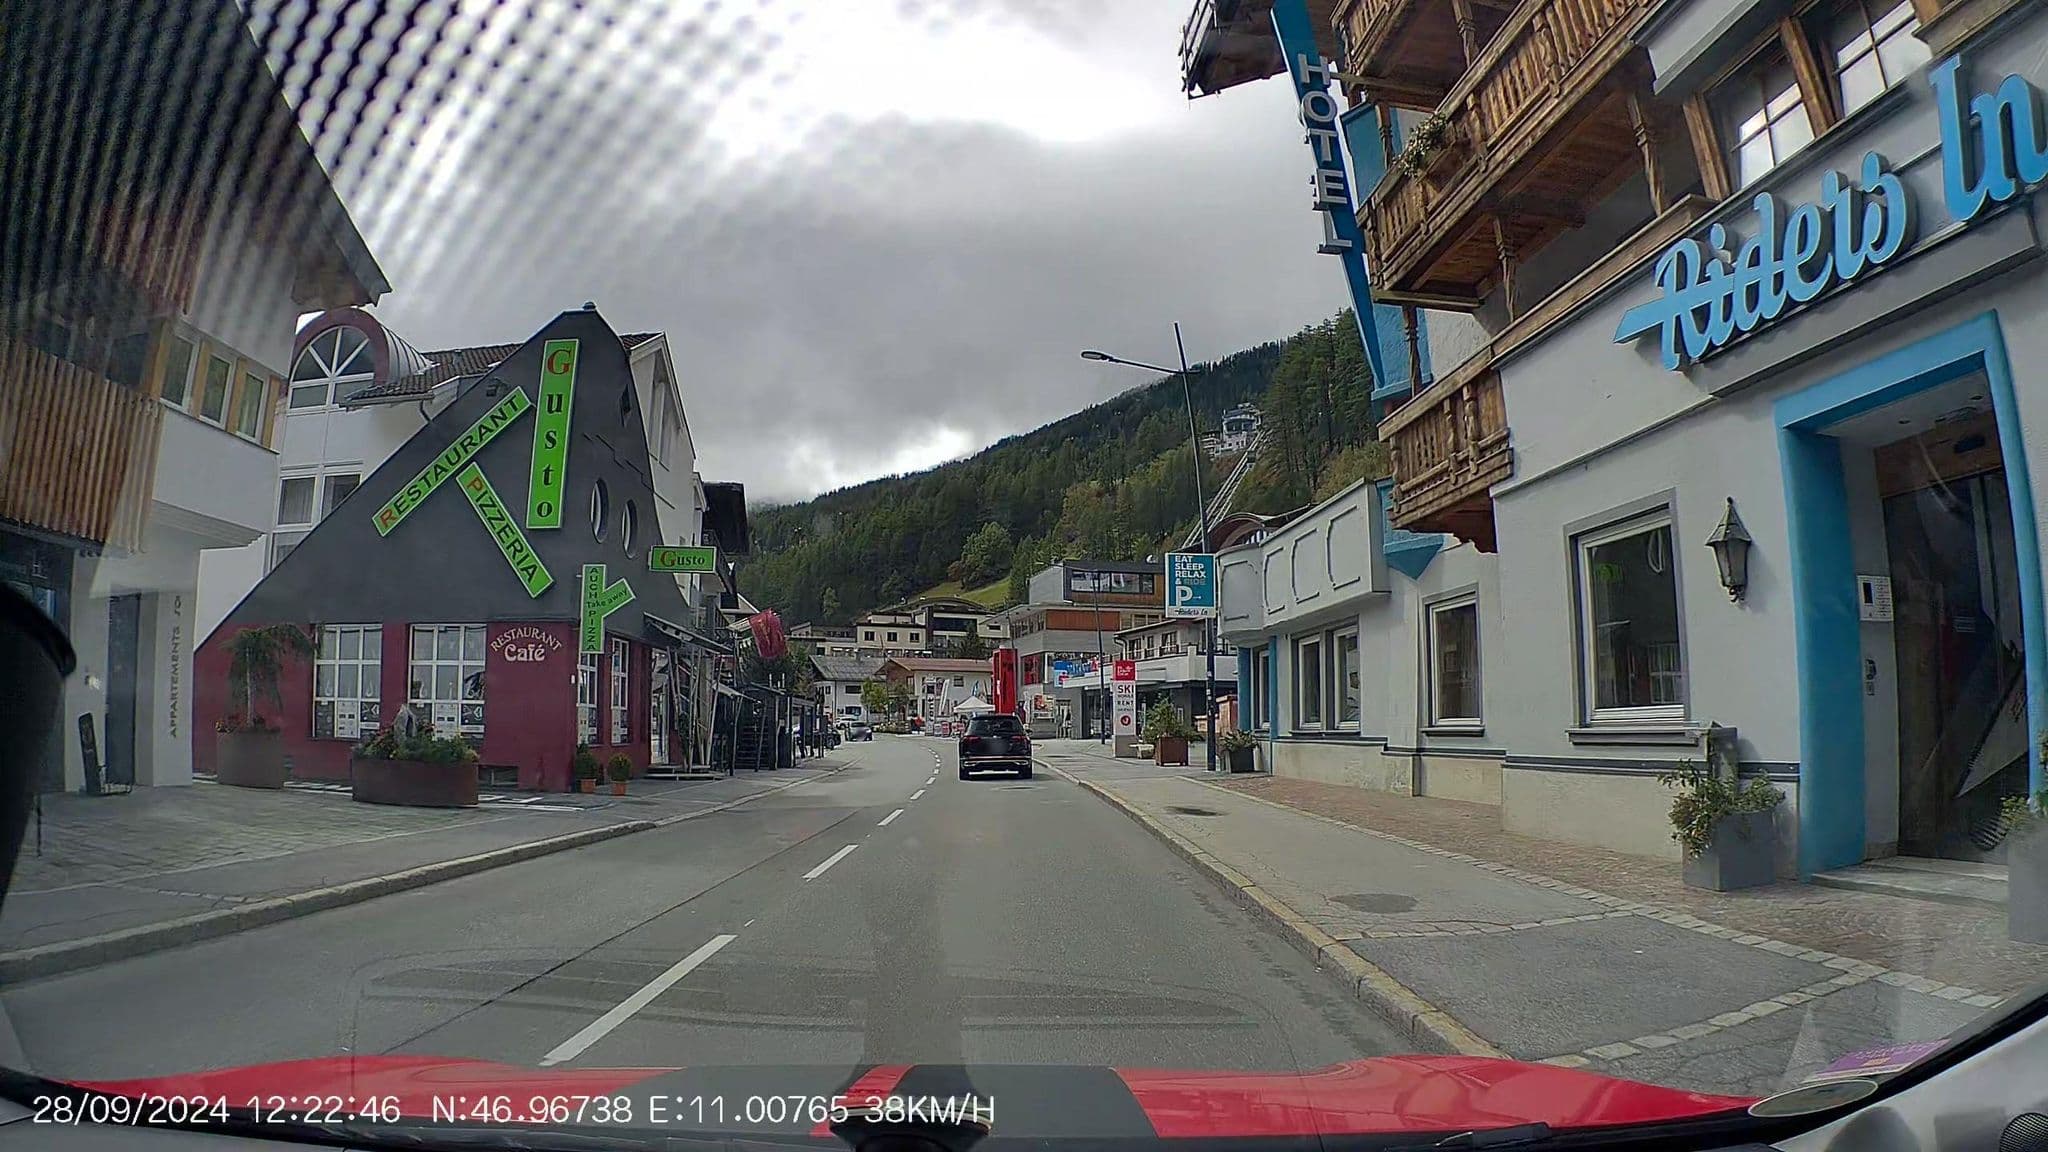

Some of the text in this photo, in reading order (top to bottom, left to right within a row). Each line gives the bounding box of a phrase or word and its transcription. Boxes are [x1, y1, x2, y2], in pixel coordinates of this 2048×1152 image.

[1298, 53, 1352, 253] HOTEL
[1613, 54, 2048, 372] Riders In
[536, 349, 572, 518] Gusto
[379, 394, 521, 528] RESTAURANT
[465, 476, 539, 586] PIZZERIA
[660, 550, 706, 567] Gusto
[586, 589, 627, 608] Take away
[589, 567, 599, 599] AUCH
[1175, 586, 1193, 609] P
[490, 627, 562, 652] RESTAURANT
[586, 610, 597, 650] PIZZA
[504, 644, 546, 661] Café
[169, 626, 181, 738] APPARTEMENTS
[1117, 685, 1134, 693] SKI
